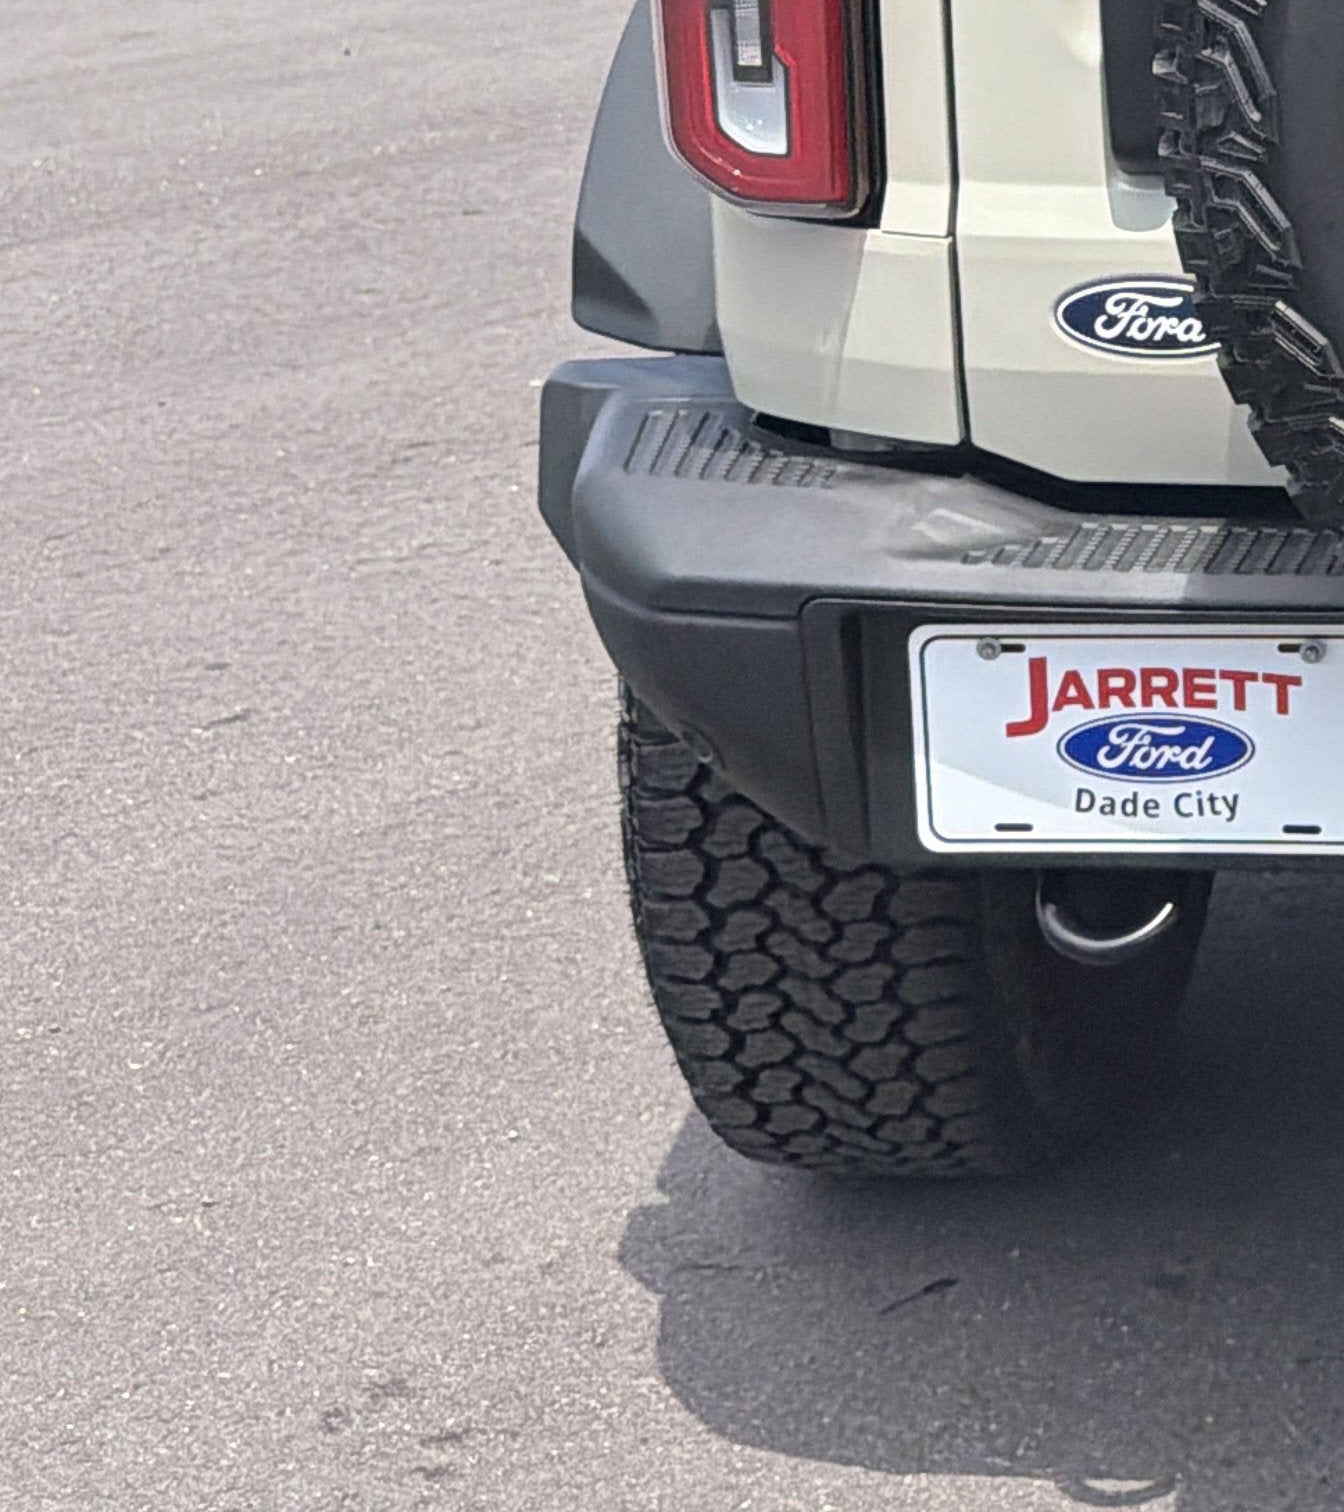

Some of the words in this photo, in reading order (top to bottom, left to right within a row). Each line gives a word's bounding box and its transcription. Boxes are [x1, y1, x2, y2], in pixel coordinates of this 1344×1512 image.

[1006, 657, 1303, 738] JARRETT
[1097, 721, 1215, 772] Ford
[1075, 788, 1160, 818] Dade
[1174, 790, 1240, 822] City
